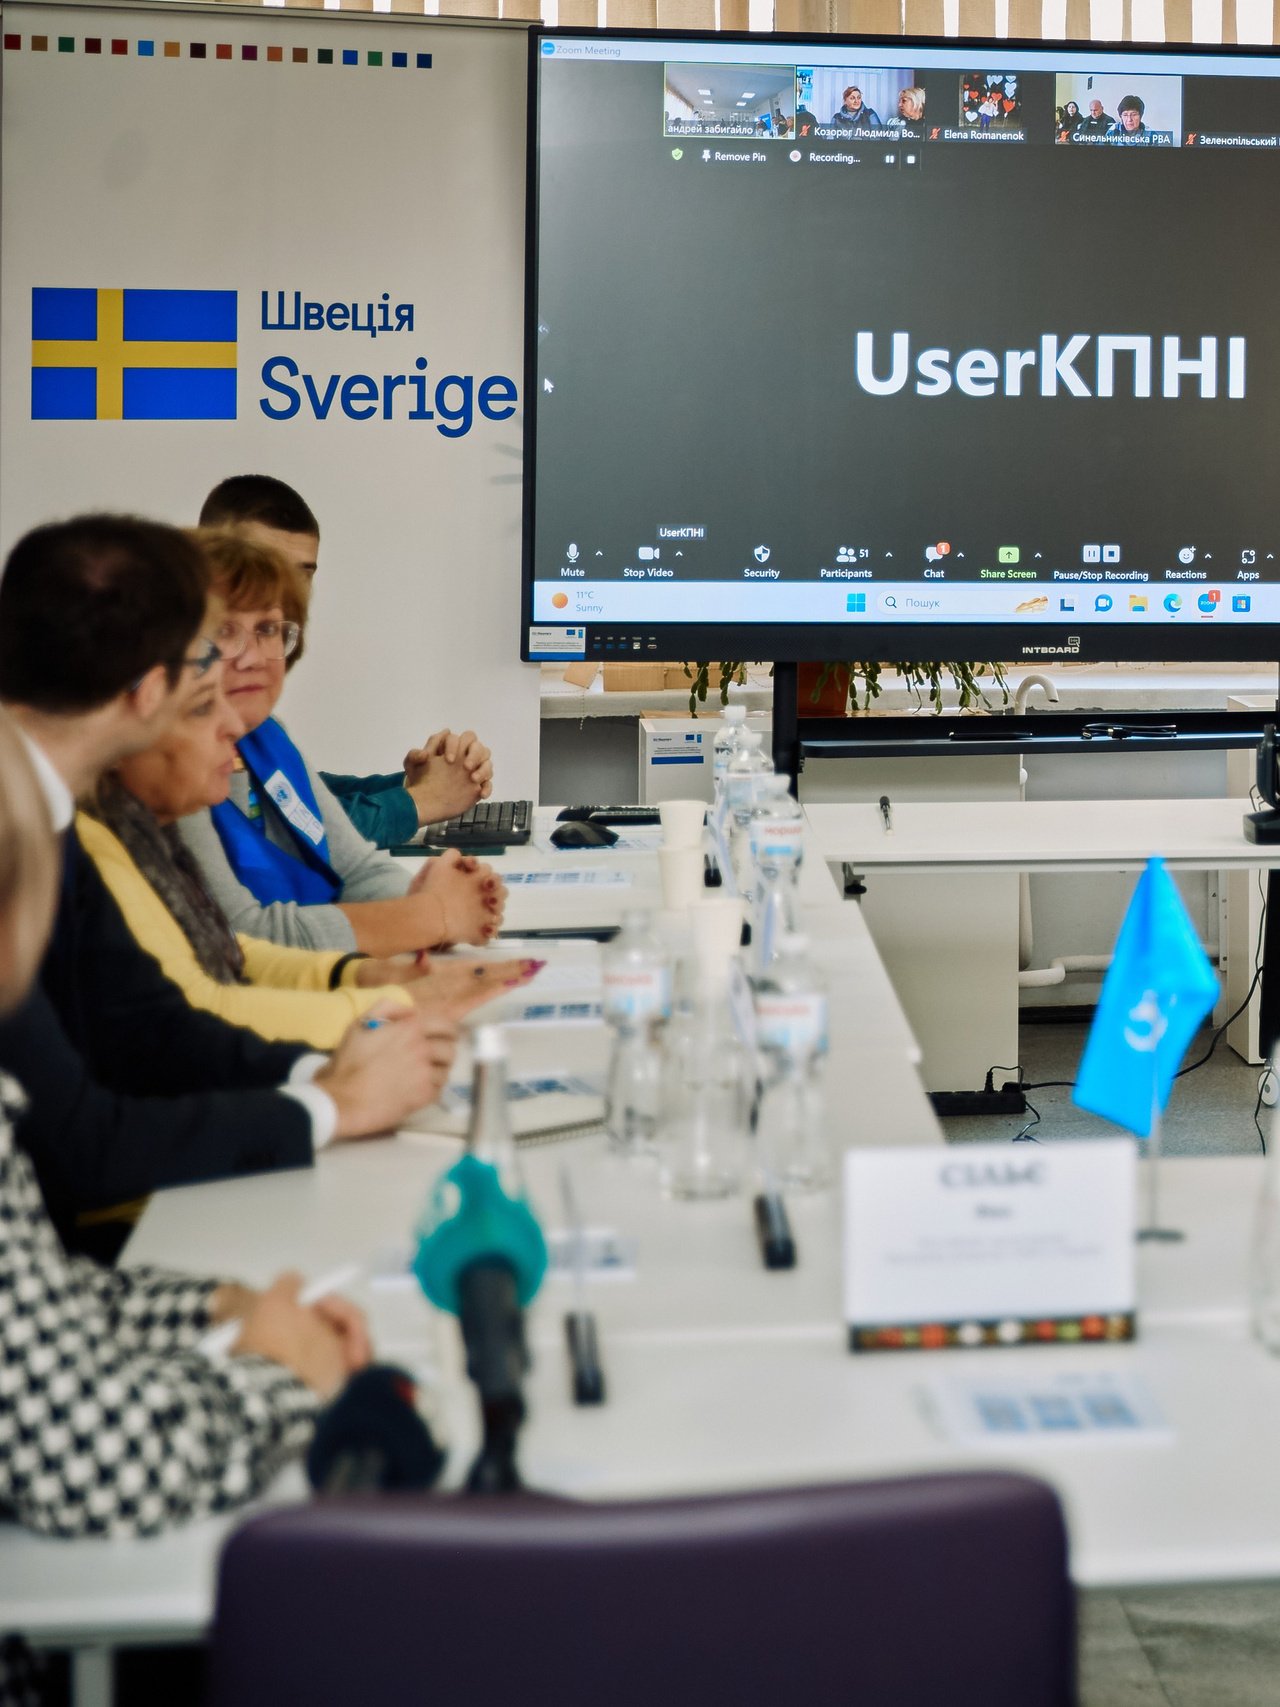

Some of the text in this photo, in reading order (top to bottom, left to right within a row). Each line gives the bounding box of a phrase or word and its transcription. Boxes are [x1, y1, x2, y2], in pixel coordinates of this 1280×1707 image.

[556, 45, 621, 57] Zoom Meeting
[667, 124, 753, 136] андрей забигайло
[814, 126, 851, 138] Козорог
[855, 128, 899, 139] Людмила
[944, 130, 1024, 140] Elena Romanenok
[1072, 132, 1171, 144] Синельниківська РВА
[1200, 135, 1277, 147] Зеленопільський
[715, 152, 766, 162] Remove Pin
[261, 290, 415, 338] Швеція
[856, 331, 1246, 398] UserКПНІ
[259, 356, 518, 438] Sverige
[859, 549, 869, 558] 51
[561, 568, 585, 577] Mute
[624, 568, 674, 580] Stop Video
[744, 568, 780, 580] Security
[820, 568, 873, 580] Participants
[924, 569, 945, 579] Chat
[980, 569, 1037, 579] Share Screen
[1054, 571, 1149, 582] Pause/Stop Recording
[1165, 570, 1207, 580] Reactions
[1237, 571, 1260, 582] Apps
[576, 603, 604, 615] Sunny
[905, 598, 940, 609] Пошук
[1022, 646, 1080, 654] INTBOARD
